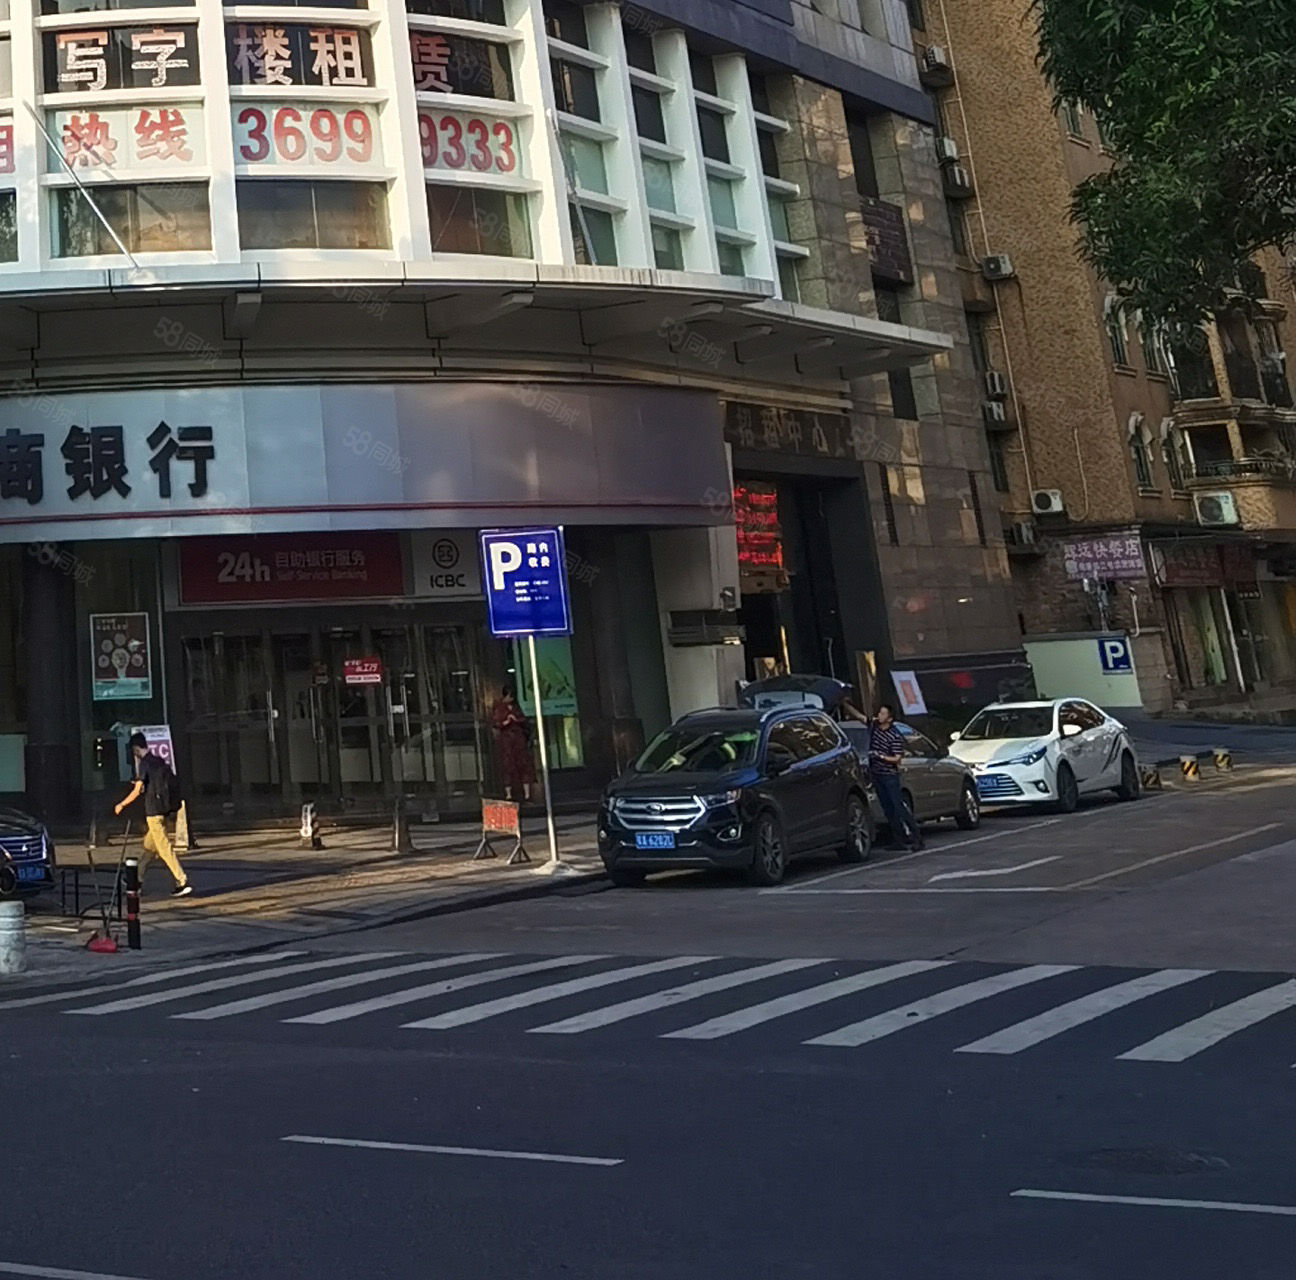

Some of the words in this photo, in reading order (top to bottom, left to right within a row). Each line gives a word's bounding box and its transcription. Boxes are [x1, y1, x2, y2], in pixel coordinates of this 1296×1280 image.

[217, 551, 271, 583] 24h
[275, 549, 366, 567] 自助银行服务
[489, 541, 522, 591] P
[430, 573, 467, 589] ICBC
[1104, 641, 1125, 668] P
